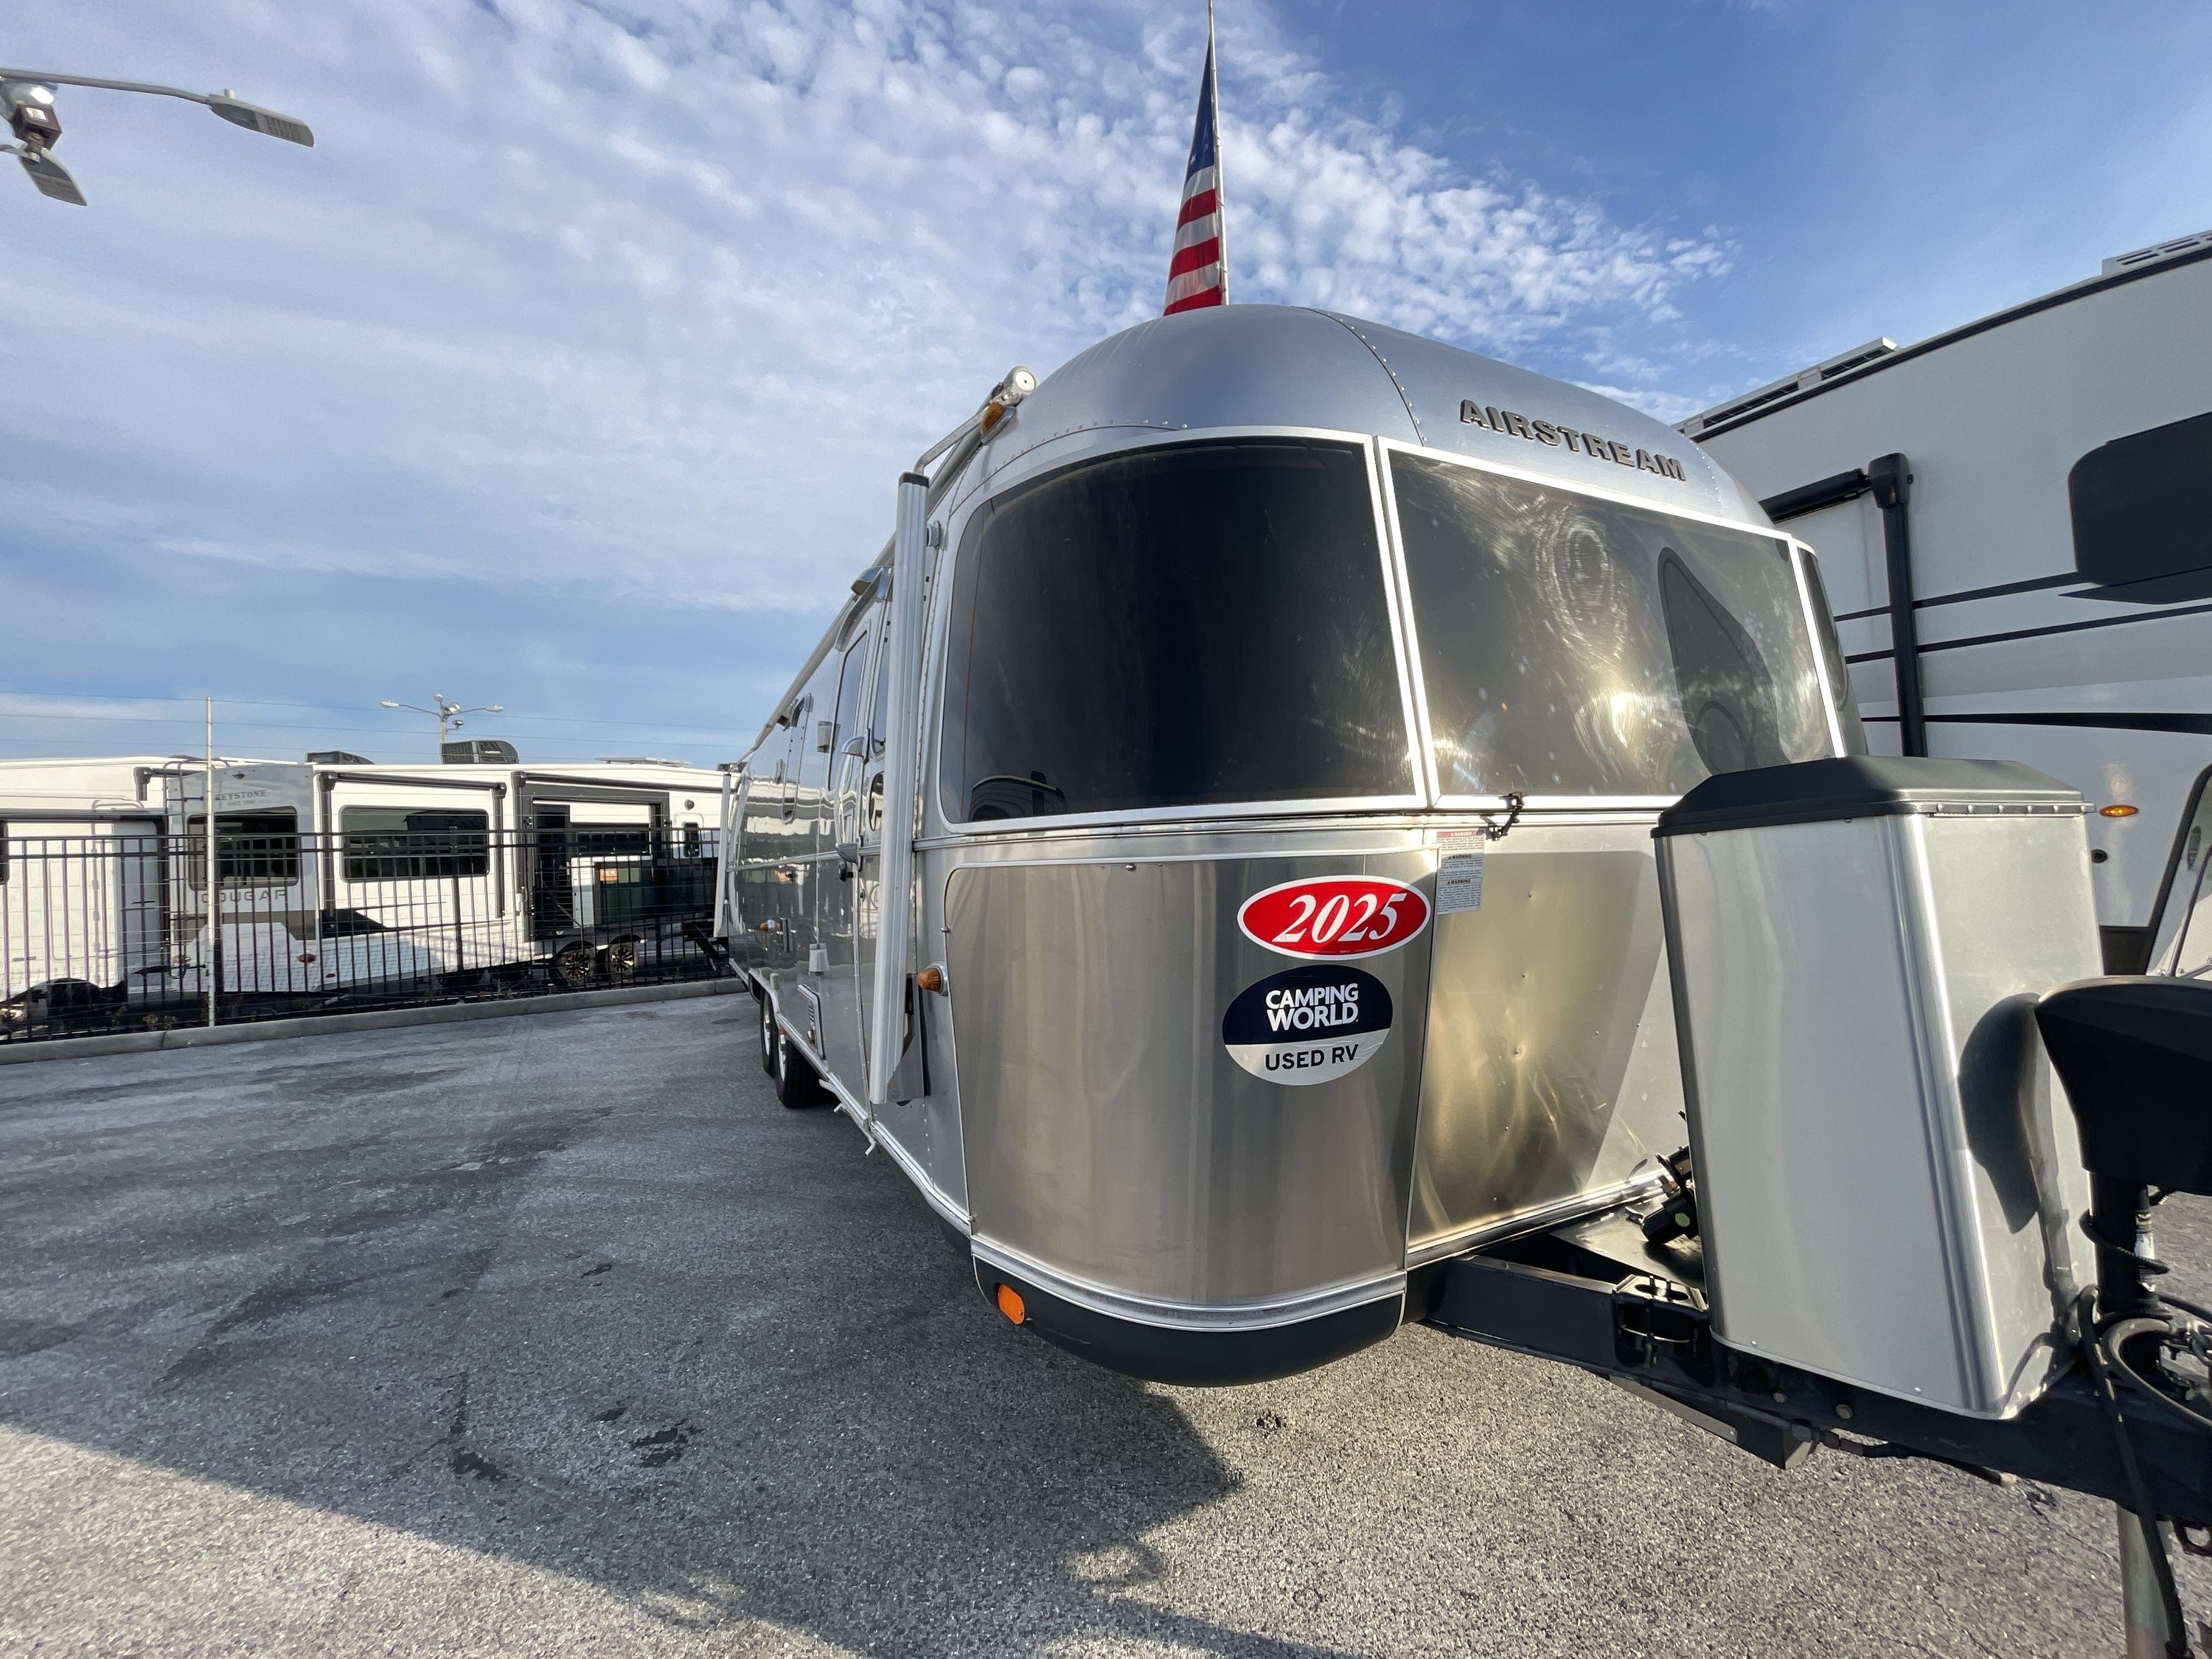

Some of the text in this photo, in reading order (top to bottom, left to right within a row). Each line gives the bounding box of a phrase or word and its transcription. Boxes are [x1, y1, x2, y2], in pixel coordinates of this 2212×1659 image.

[1460, 399, 1686, 481] AIRSTREAM
[1272, 893, 1407, 944] 2025
[1265, 983, 1358, 1010] CAMPING
[1266, 1003, 1359, 1032] WORLD
[1265, 1044, 1359, 1071] USED RV
